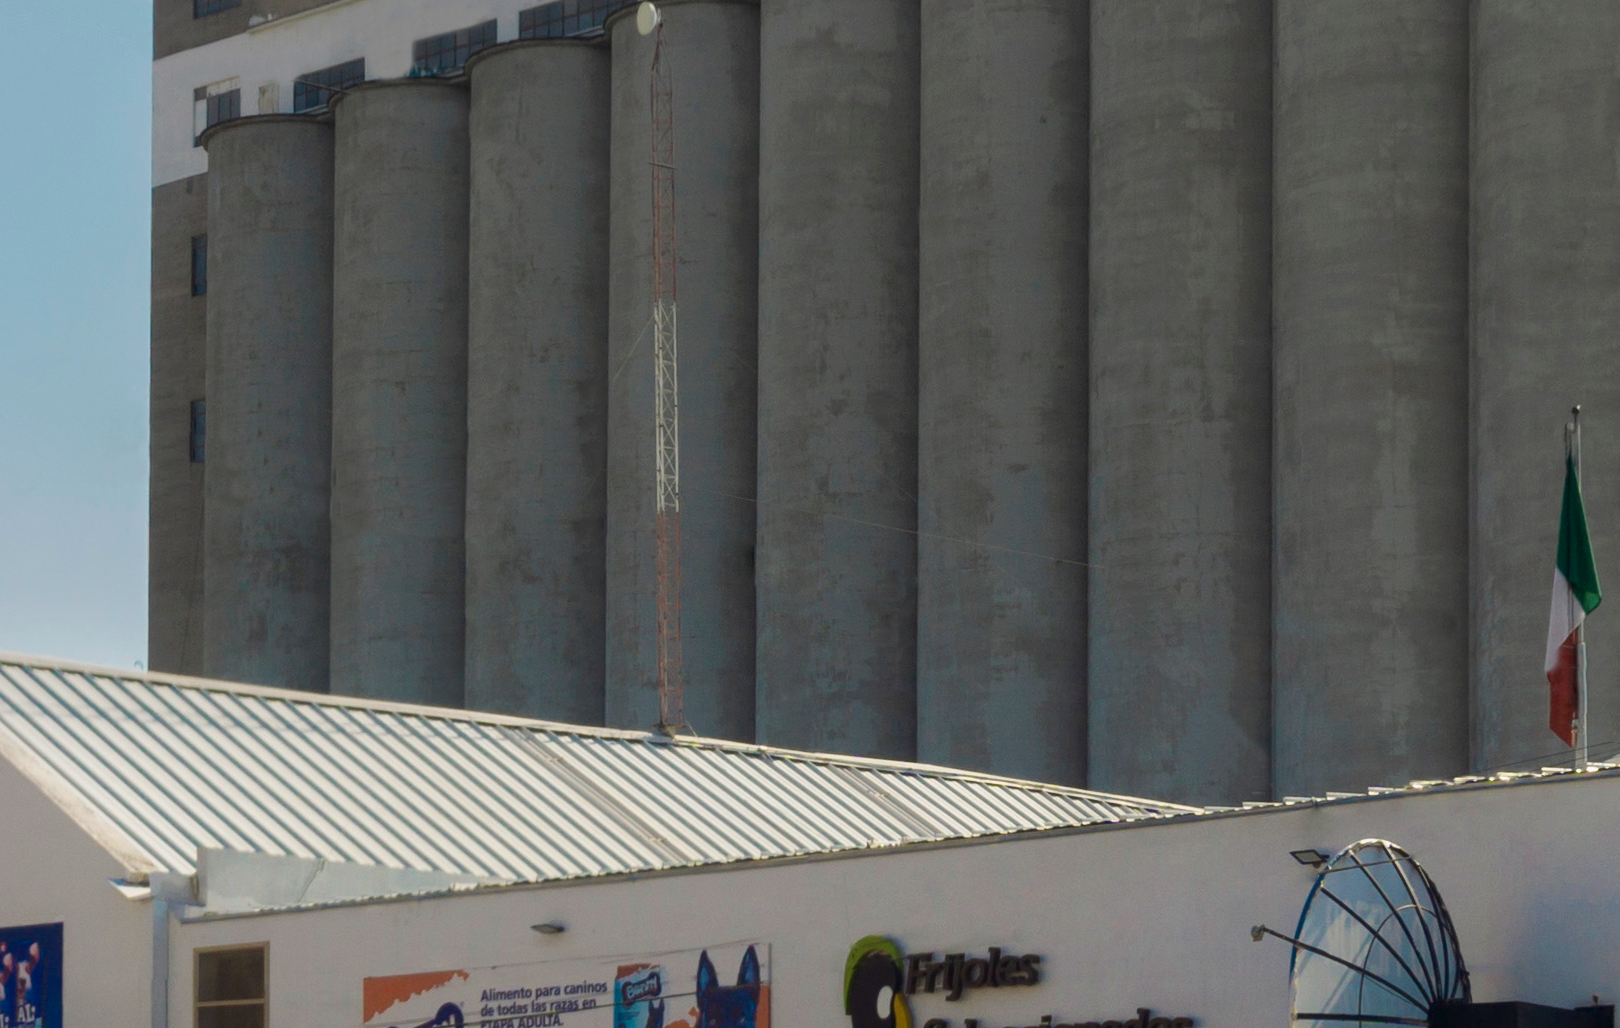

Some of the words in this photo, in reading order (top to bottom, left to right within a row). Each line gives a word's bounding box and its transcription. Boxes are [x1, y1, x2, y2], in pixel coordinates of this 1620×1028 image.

[905, 946, 1041, 1002] Frijoles
[480, 987, 533, 1002] Alimento
[535, 985, 561, 999] para
[563, 980, 608, 995] caninos
[480, 1003, 495, 1017] de
[497, 1001, 528, 1016] todas
[531, 1000, 547, 1013] las
[549, 999, 579, 1013] razas
[582, 998, 597, 1009] en
[517, 1014, 564, 1028] ADULTA.
